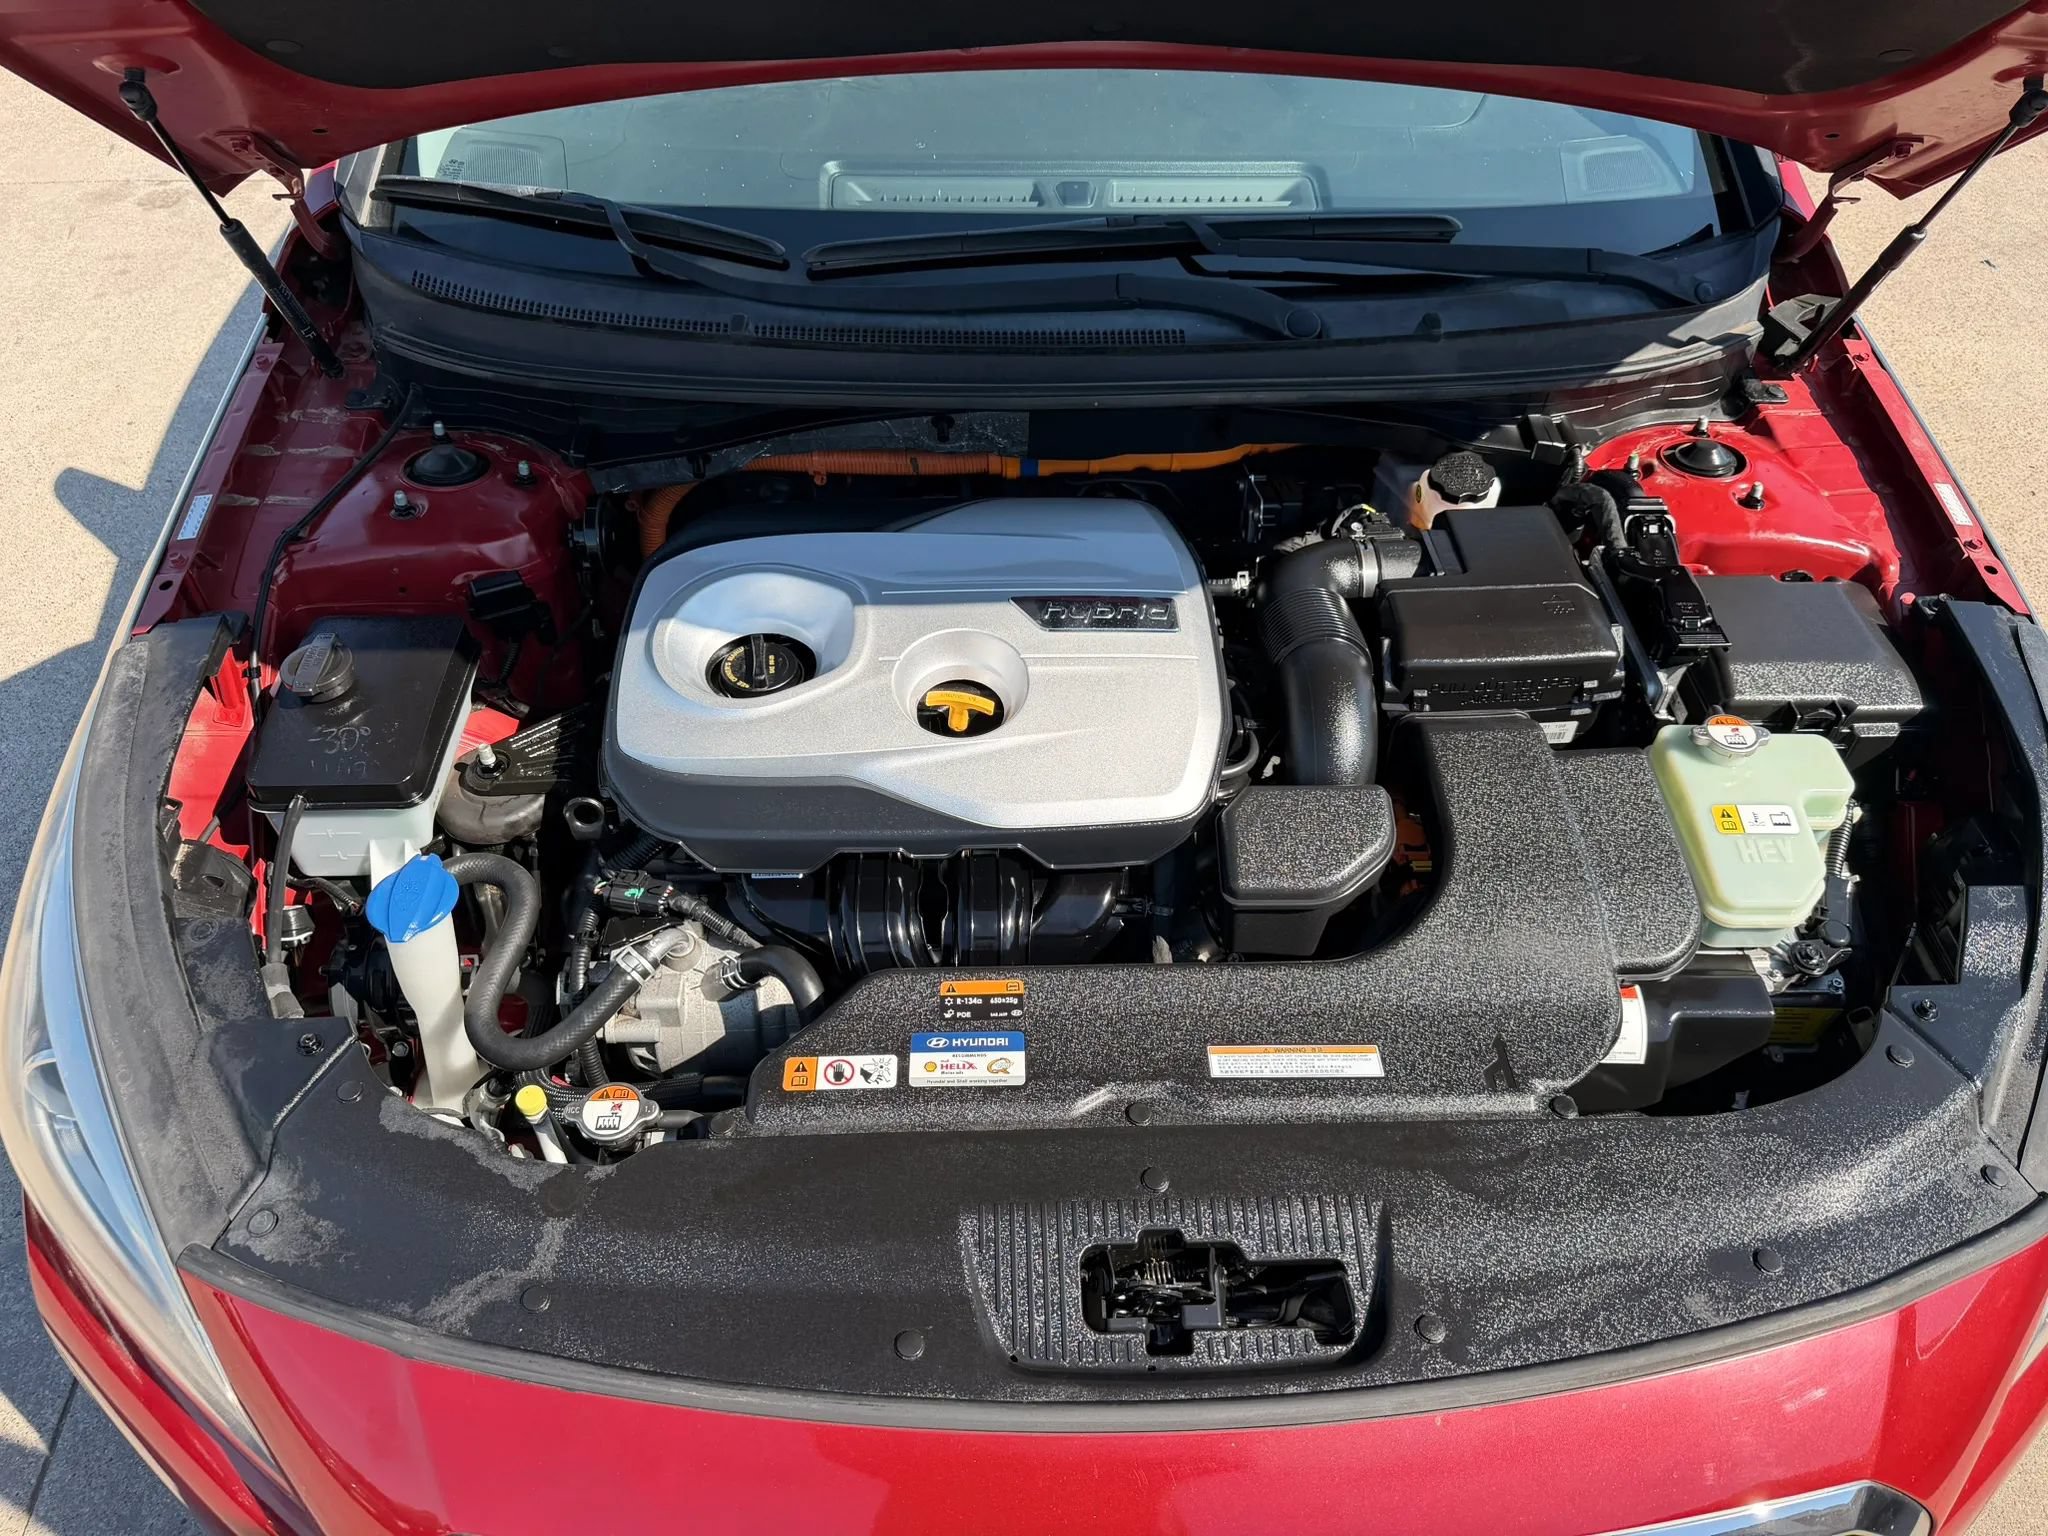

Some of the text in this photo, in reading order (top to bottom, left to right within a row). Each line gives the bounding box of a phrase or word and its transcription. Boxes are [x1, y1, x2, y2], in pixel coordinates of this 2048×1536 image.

[1043, 601, 1172, 623] hybrid
[1734, 838, 1794, 864] HEV
[956, 997, 983, 1005] R-134a
[952, 1037, 1009, 1047] HYUNDAI
[940, 1061, 977, 1070] HELIX
